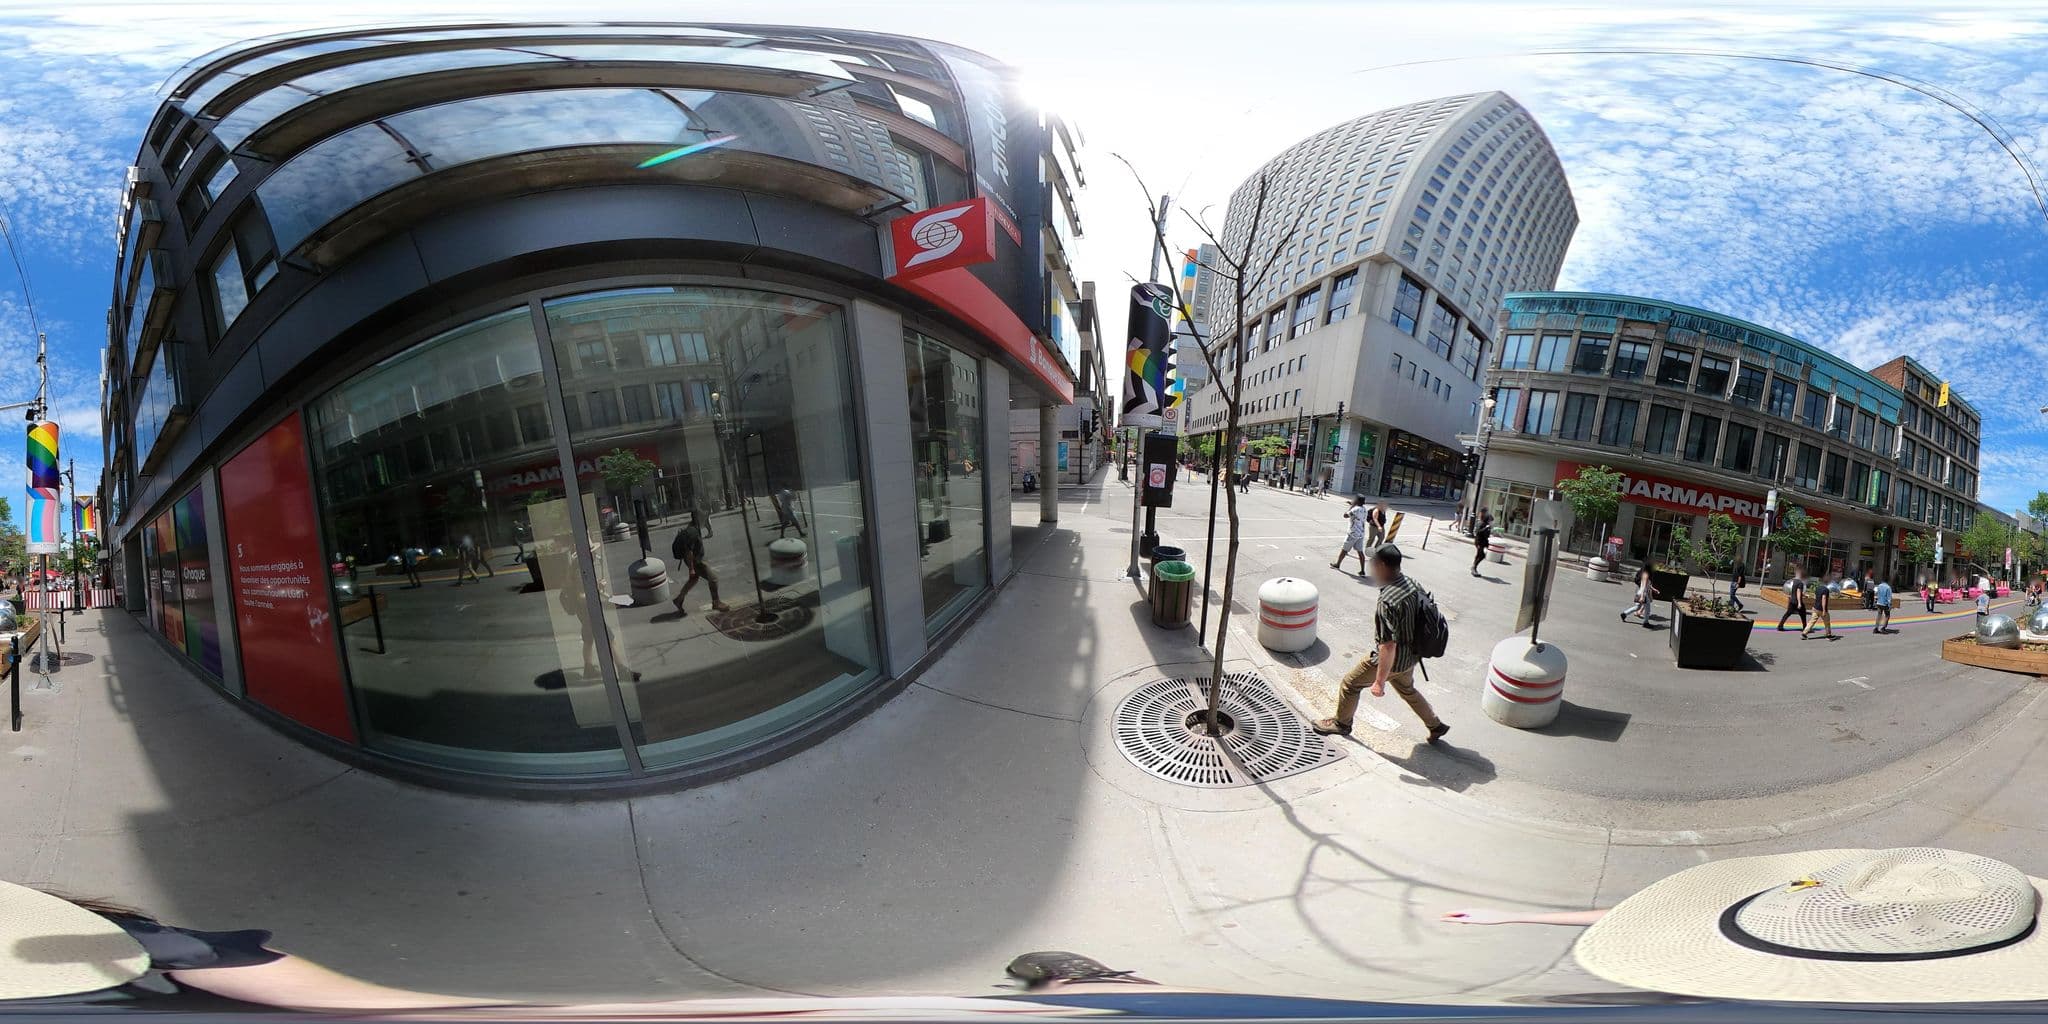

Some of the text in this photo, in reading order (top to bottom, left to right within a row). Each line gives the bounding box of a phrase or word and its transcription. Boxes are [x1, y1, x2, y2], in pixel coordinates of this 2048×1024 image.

[271, 560, 298, 572] engagés
[298, 559, 304, 569] à
[183, 566, 206, 582] Chaque
[269, 574, 310, 586] opportunités
